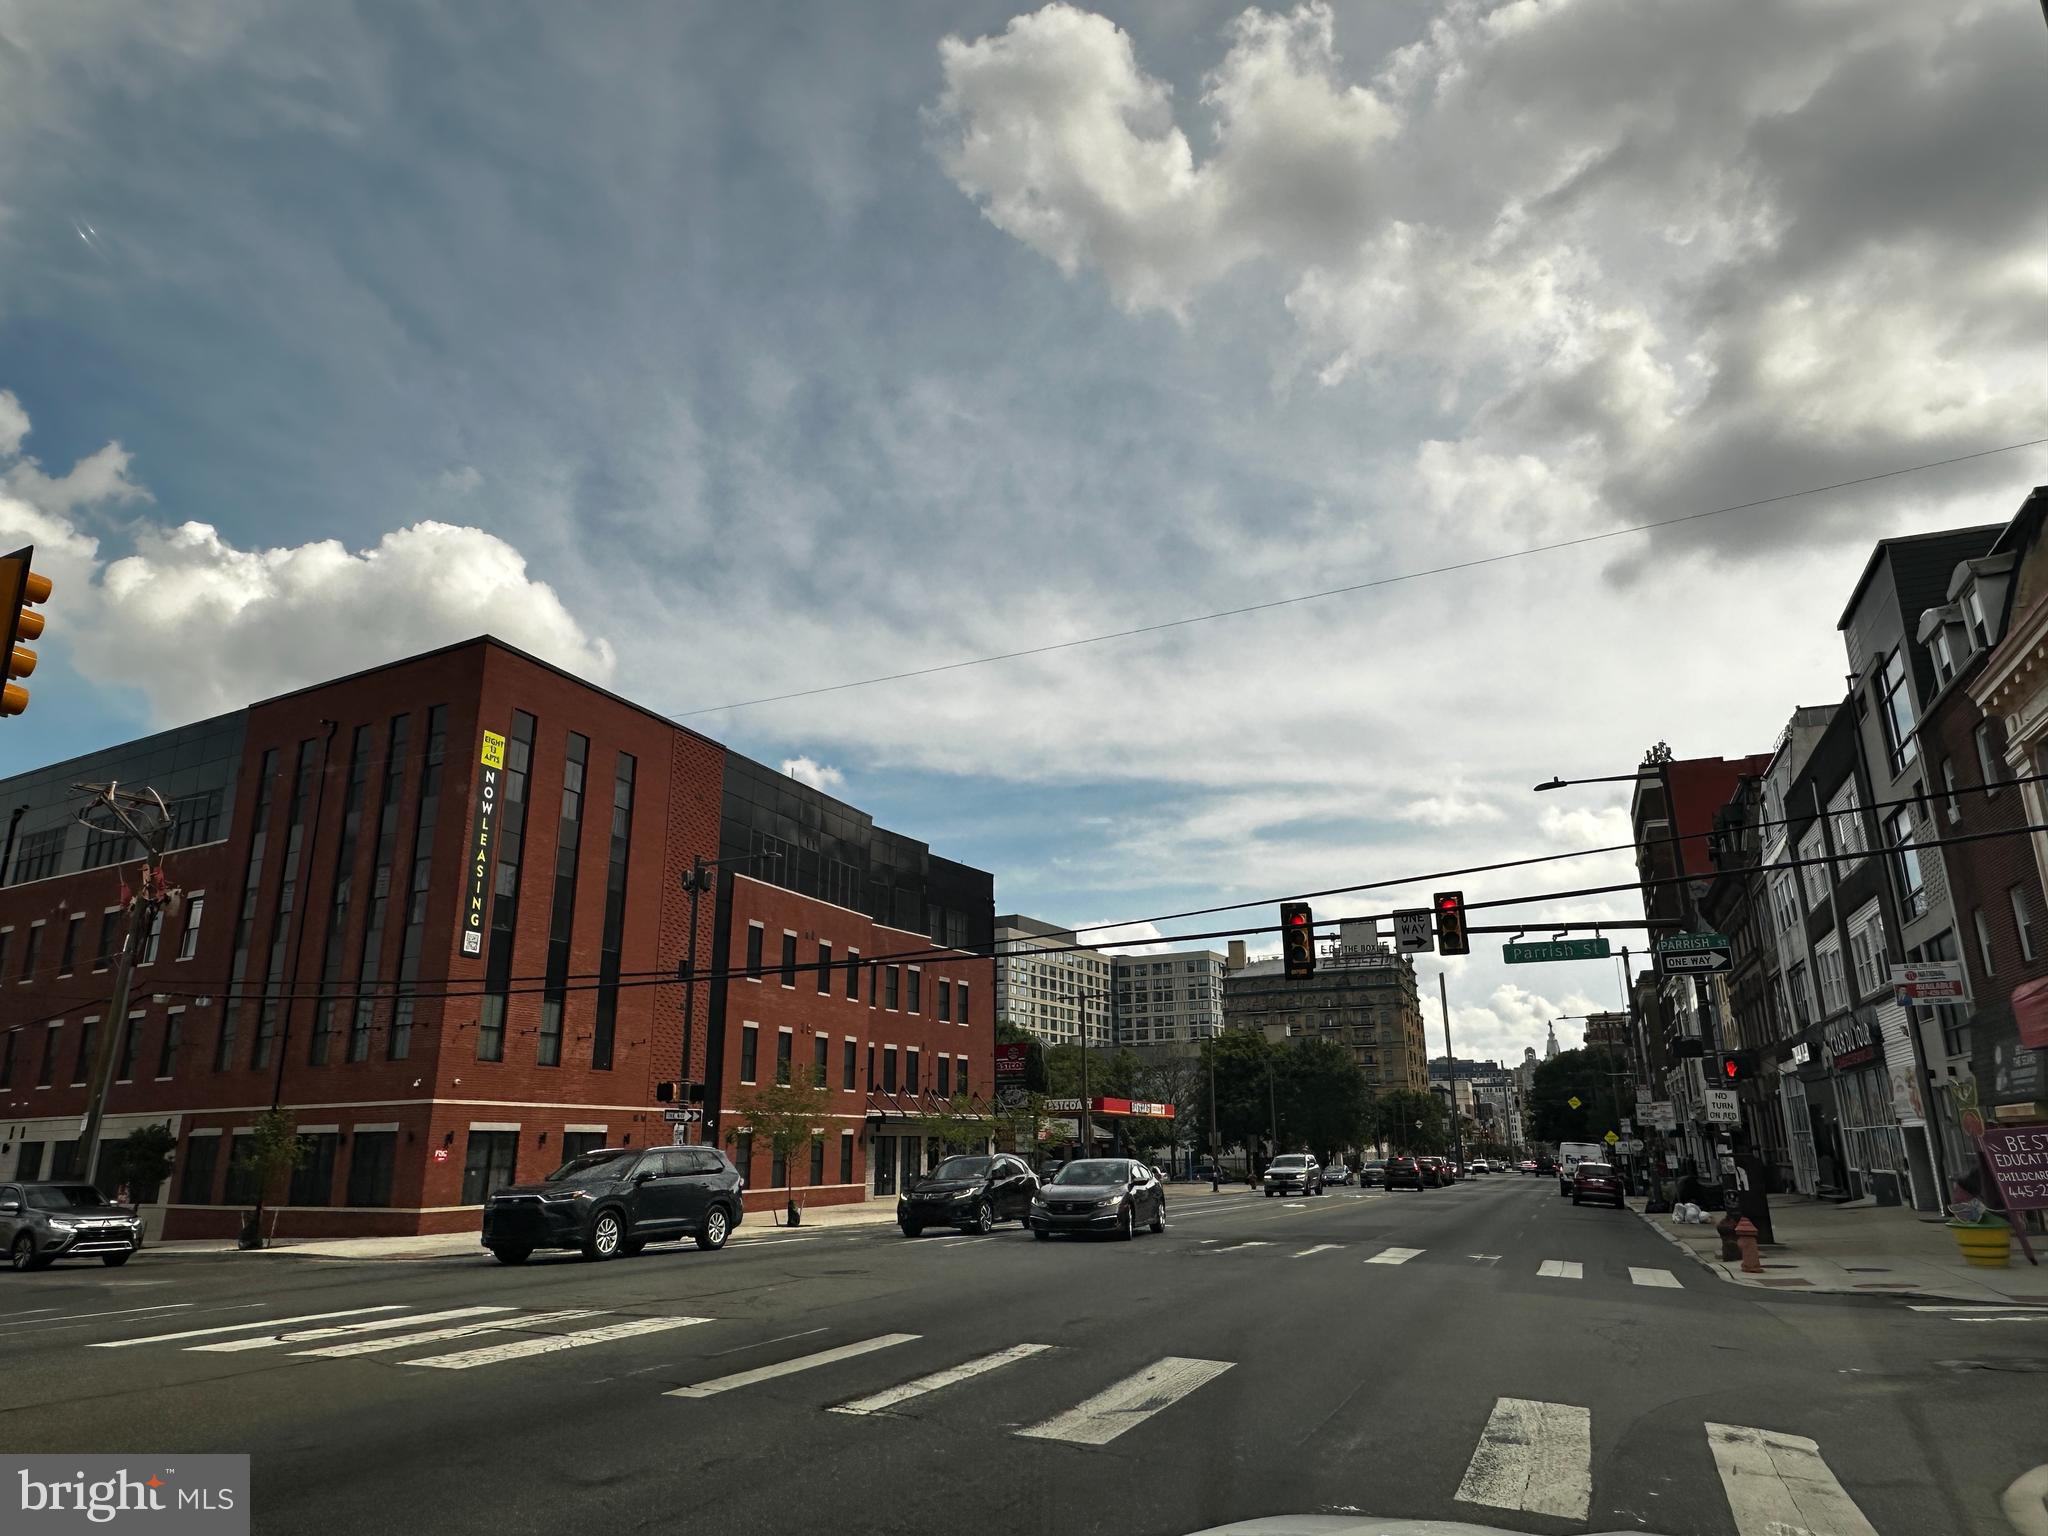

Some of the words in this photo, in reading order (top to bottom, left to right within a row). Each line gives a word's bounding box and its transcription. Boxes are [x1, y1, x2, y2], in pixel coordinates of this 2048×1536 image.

[485, 736, 503, 748] EIGHT
[484, 754, 500, 764] APTS
[482, 771, 495, 815] NOW
[470, 817, 489, 927] LEASING
[1401, 913, 1424, 923] ONE
[1401, 924, 1426, 935] WAY
[1344, 945, 1359, 953] THE
[1361, 944, 1376, 952] BOX
[1660, 937, 1710, 951] PARRISH
[1513, 943, 1574, 960] Parrish
[1583, 941, 1601, 955] St
[1668, 957, 1689, 966] ONE
[1691, 955, 1712, 965] WAY
[1715, 1092, 1728, 1100] NO
[1043, 1100, 1093, 1111] ASTCOAT
[1711, 1101, 1734, 1110] TURN
[1709, 1111, 1721, 1119] ON
[1722, 1112, 1738, 1121] RED
[2008, 1183, 2048, 1199] 445-2
